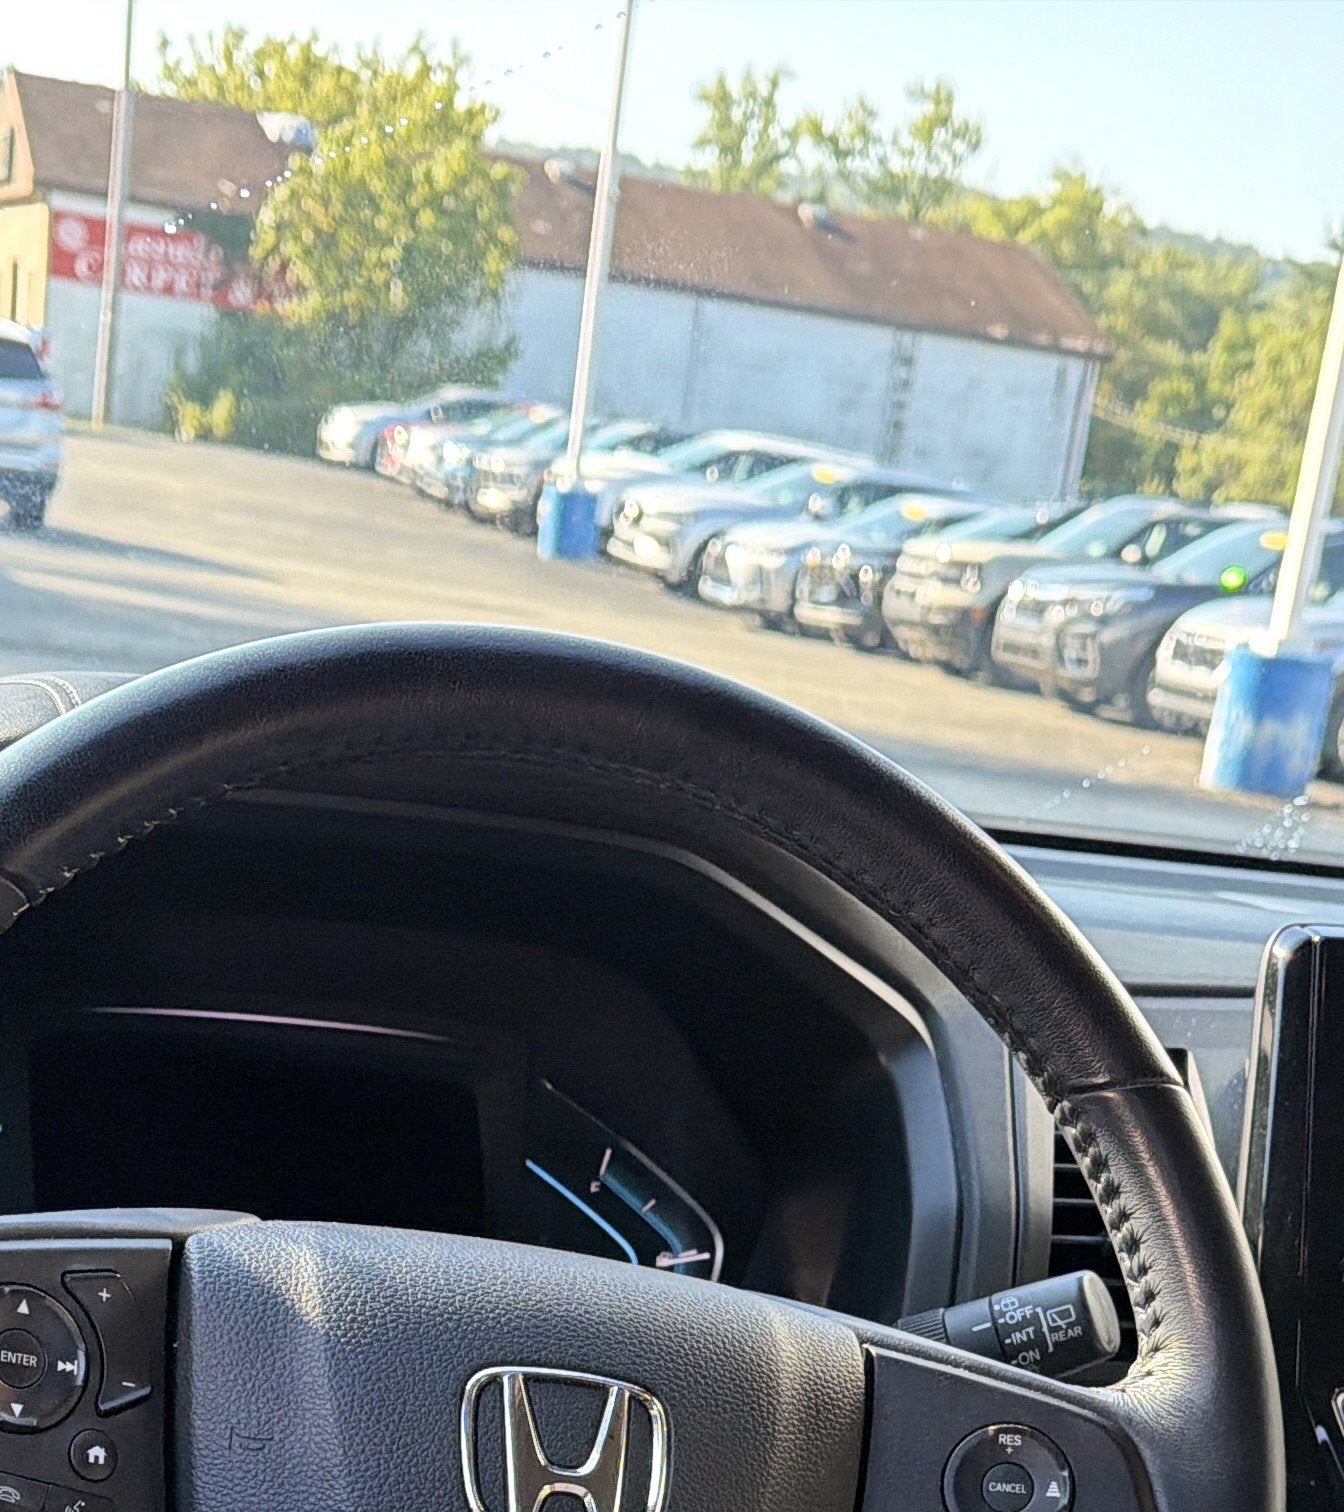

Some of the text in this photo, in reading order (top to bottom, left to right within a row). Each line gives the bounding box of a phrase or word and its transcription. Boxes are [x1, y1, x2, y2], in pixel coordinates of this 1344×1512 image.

[1005, 1304, 1034, 1325] OFF
[1011, 1326, 1036, 1346] INT
[1051, 1325, 1083, 1343] REAR
[0, 1350, 37, 1368] ENTER
[1017, 1348, 1041, 1366] ON
[999, 1434, 1022, 1446] RES
[988, 1482, 1027, 1494] CANCEL
